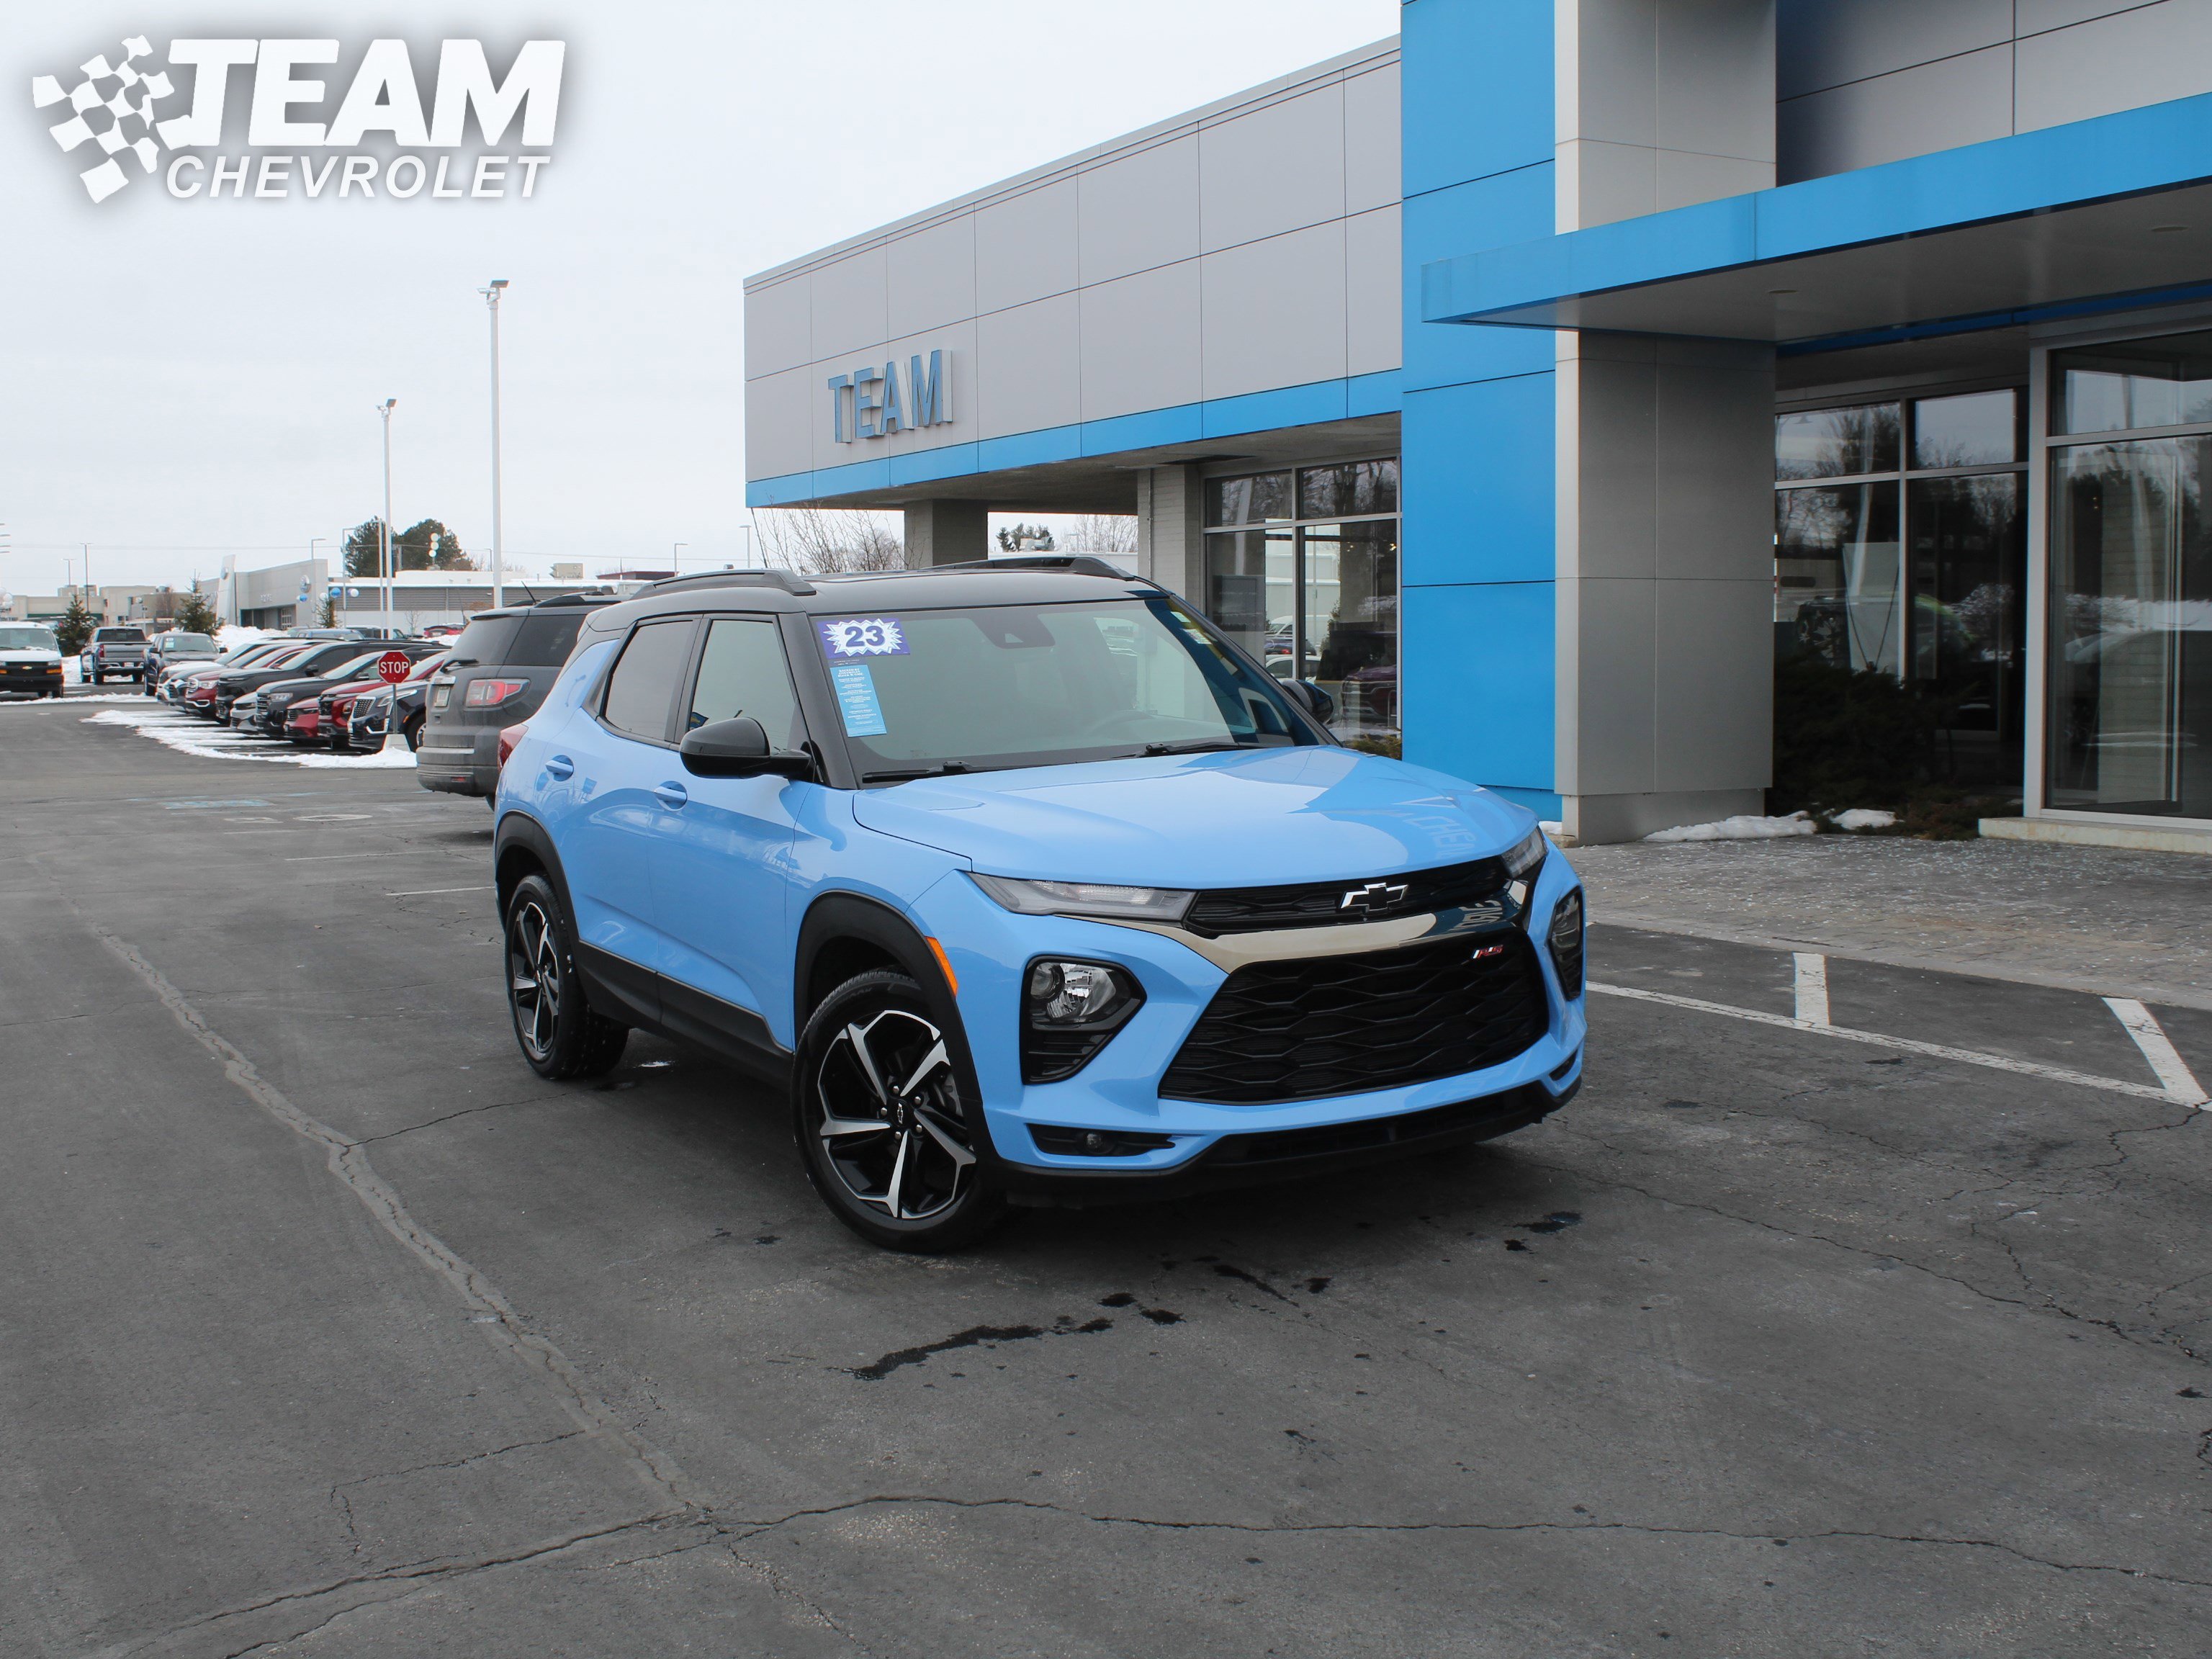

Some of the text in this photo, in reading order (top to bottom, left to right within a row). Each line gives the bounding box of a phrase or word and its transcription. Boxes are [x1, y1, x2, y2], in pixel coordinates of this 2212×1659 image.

[827, 349, 953, 444] TEAM
[844, 625, 886, 648] 23
[379, 661, 409, 674] STOP
[1472, 944, 1504, 959] RS
